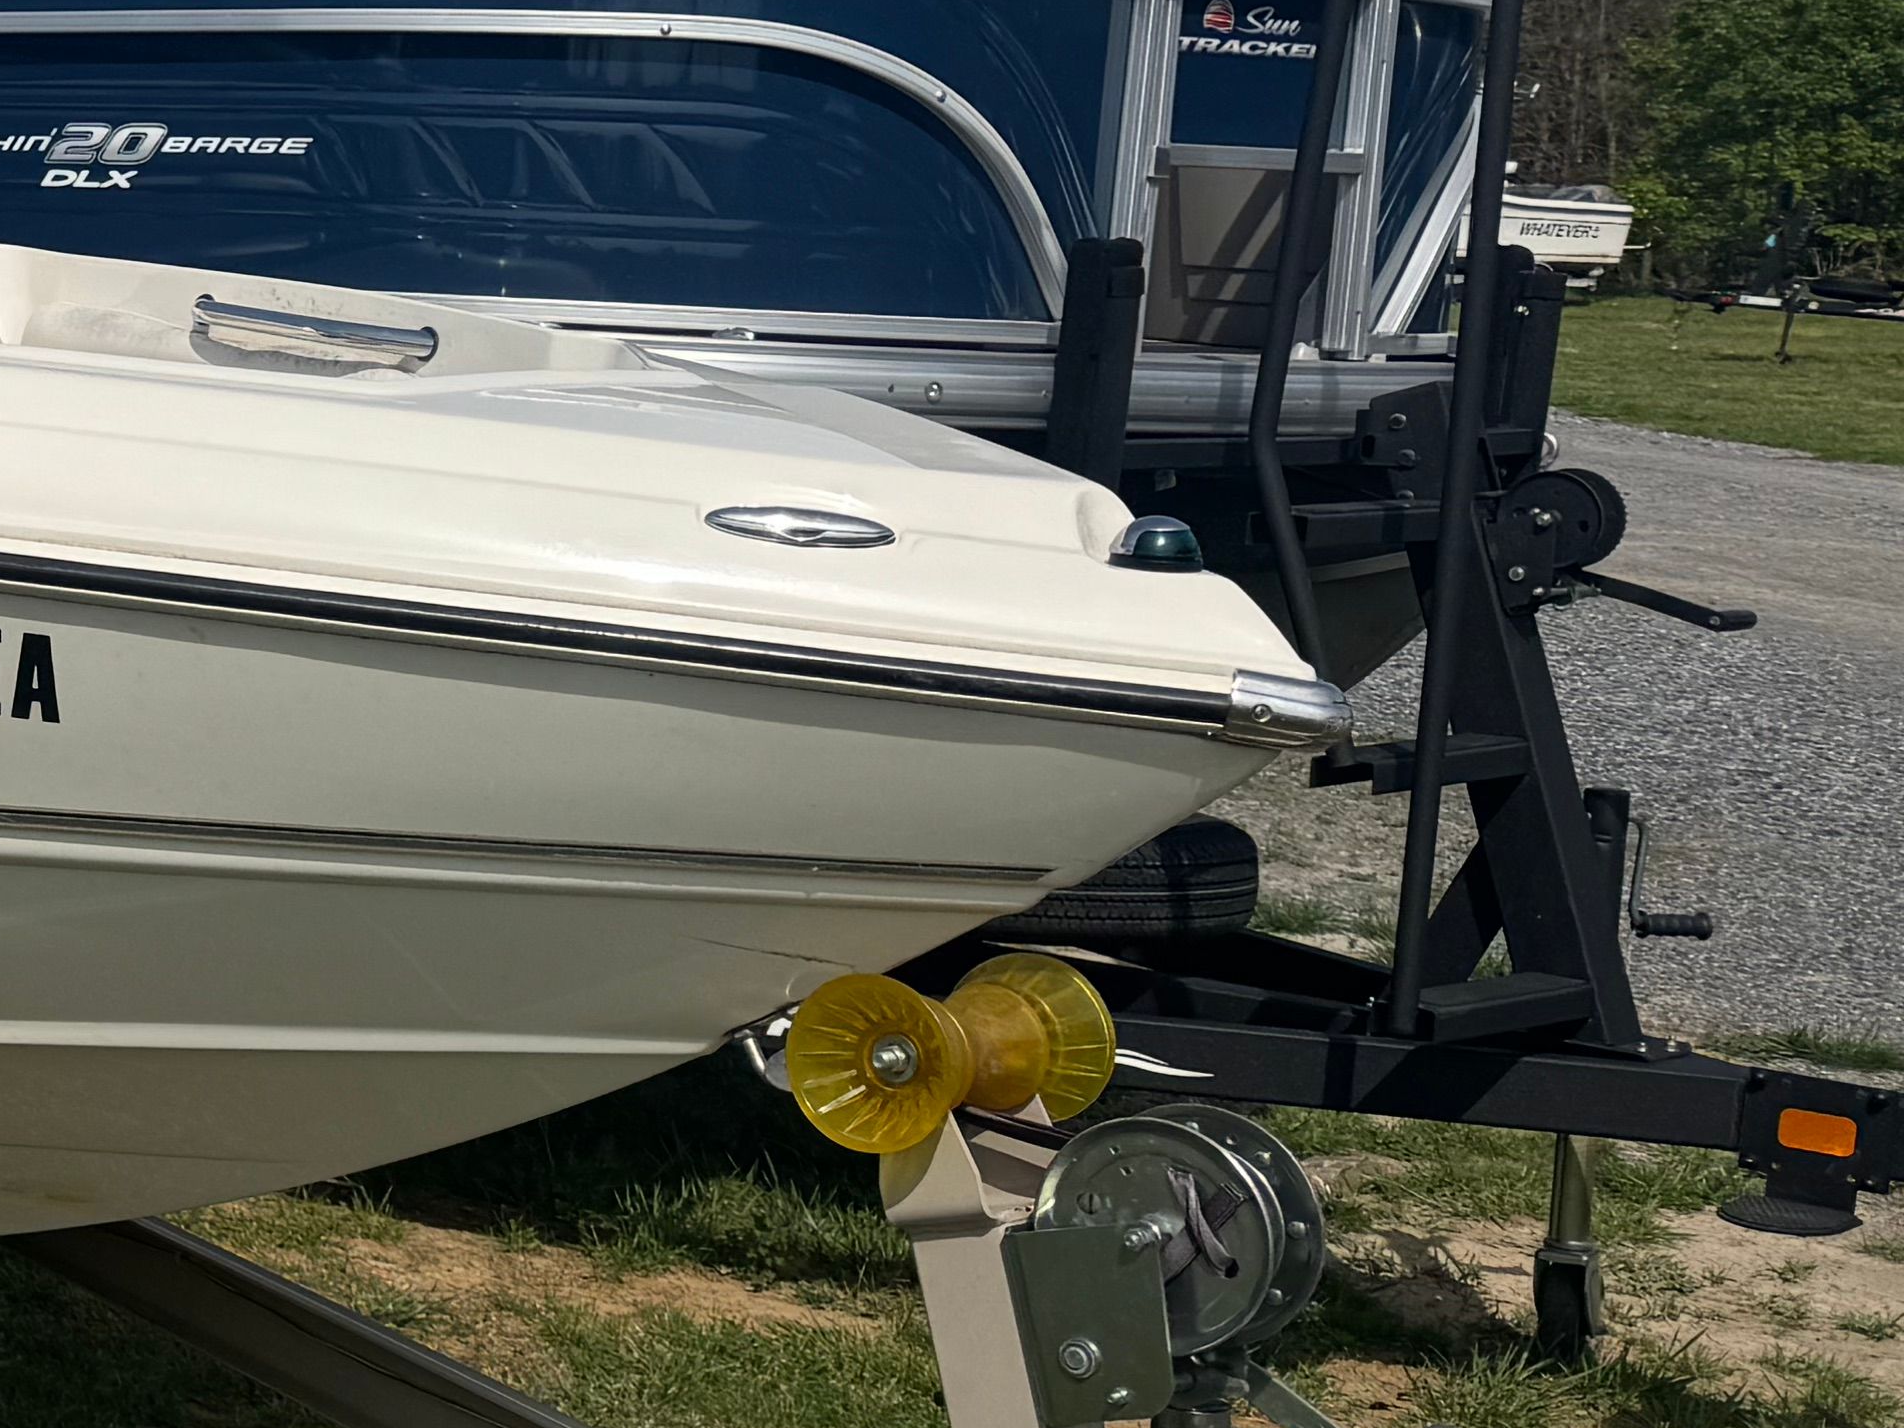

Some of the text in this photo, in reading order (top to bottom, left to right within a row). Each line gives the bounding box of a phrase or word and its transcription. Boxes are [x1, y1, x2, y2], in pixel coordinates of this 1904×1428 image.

[1235, 6, 1302, 37] Sun
[1178, 36, 1317, 59] TRACKE
[44, 122, 168, 165] 20
[160, 136, 314, 155] BARGE
[40, 169, 138, 189] DLX
